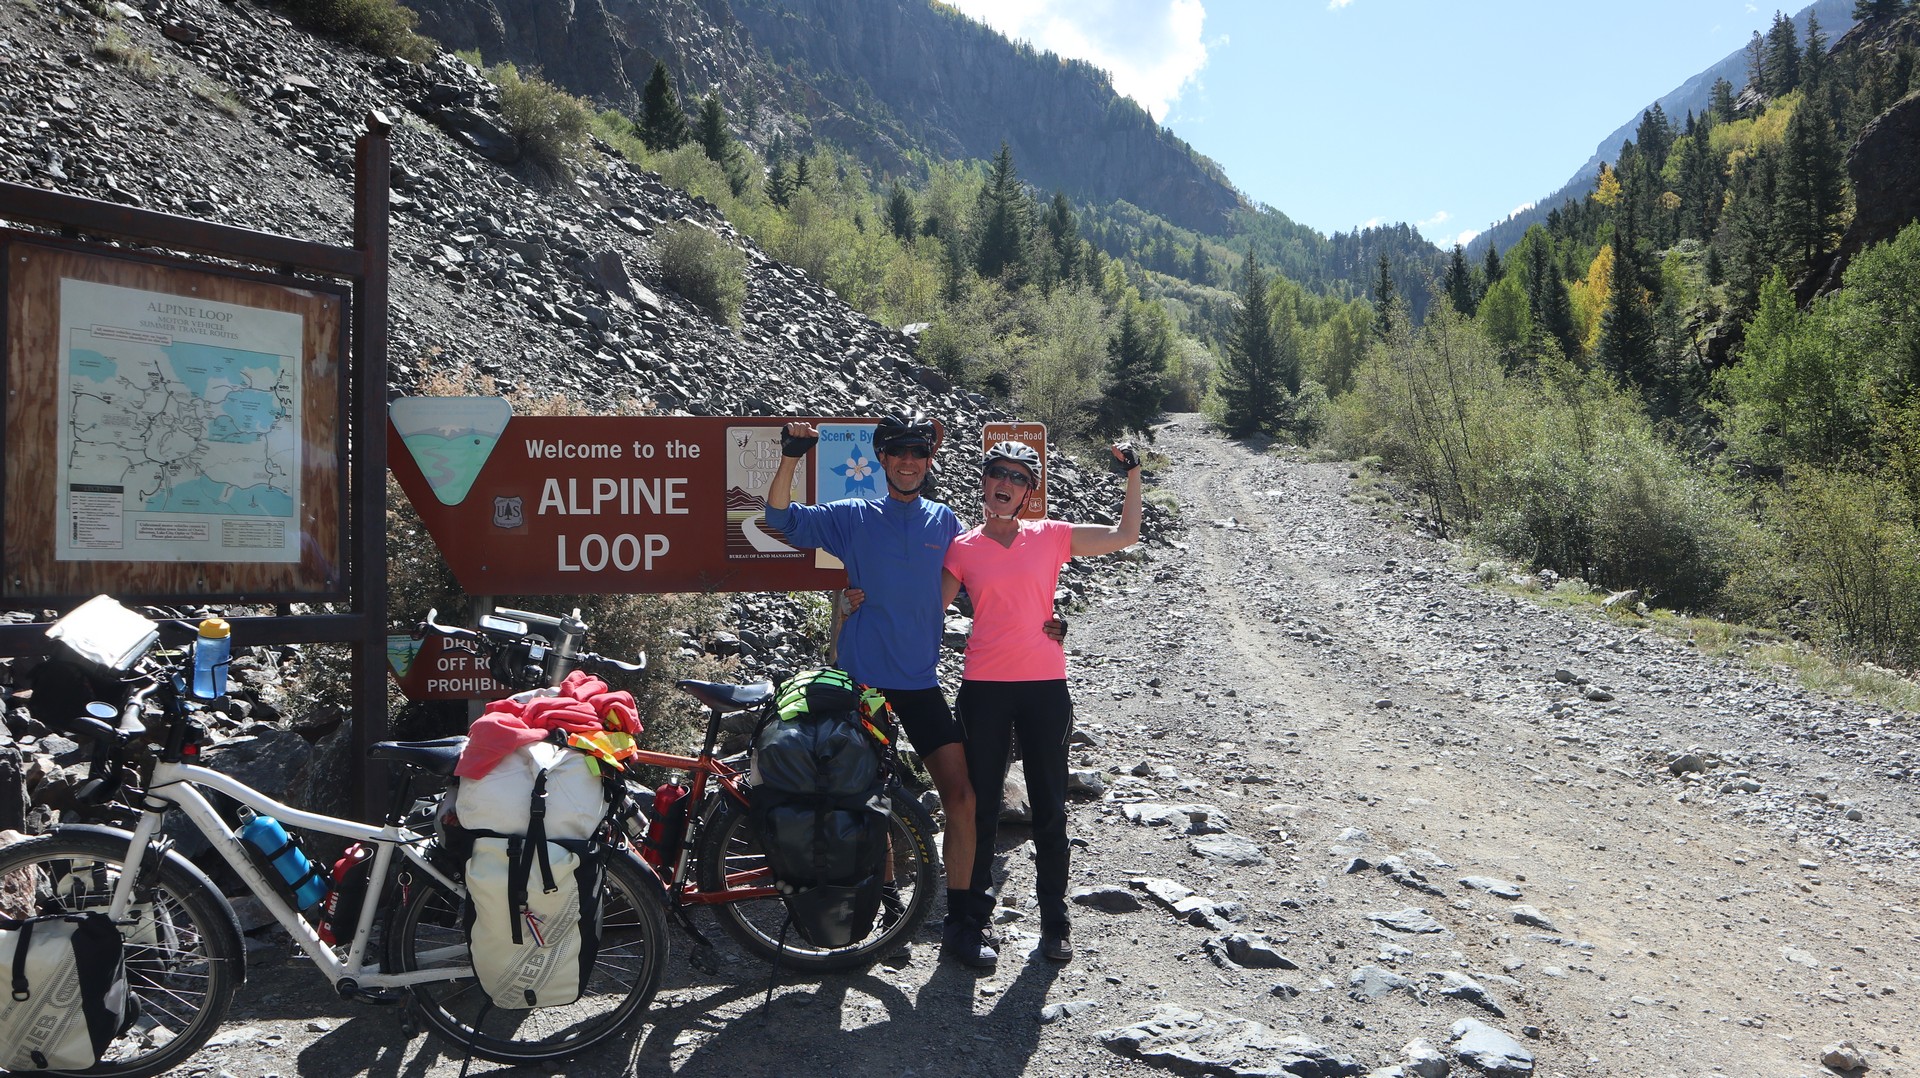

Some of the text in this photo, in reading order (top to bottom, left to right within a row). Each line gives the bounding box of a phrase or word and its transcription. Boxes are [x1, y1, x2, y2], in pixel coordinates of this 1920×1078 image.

[147, 302, 233, 322] ALPINE LOOP
[139, 320, 176, 331] SUMMER
[178, 325, 207, 336] TRAVEL
[209, 330, 239, 340] ROUTES
[158, 316, 225, 331] MOTOR VEHICLE
[820, 429, 856, 442] Scenic
[987, 431, 1043, 442] Adopt-a-Road
[525, 439, 701, 459] Welcome to the
[537, 477, 689, 515] ALPINE
[557, 533, 671, 572] LOOP
[437, 657, 468, 671] OFF
[901, 816, 929, 864] MAXXIS
